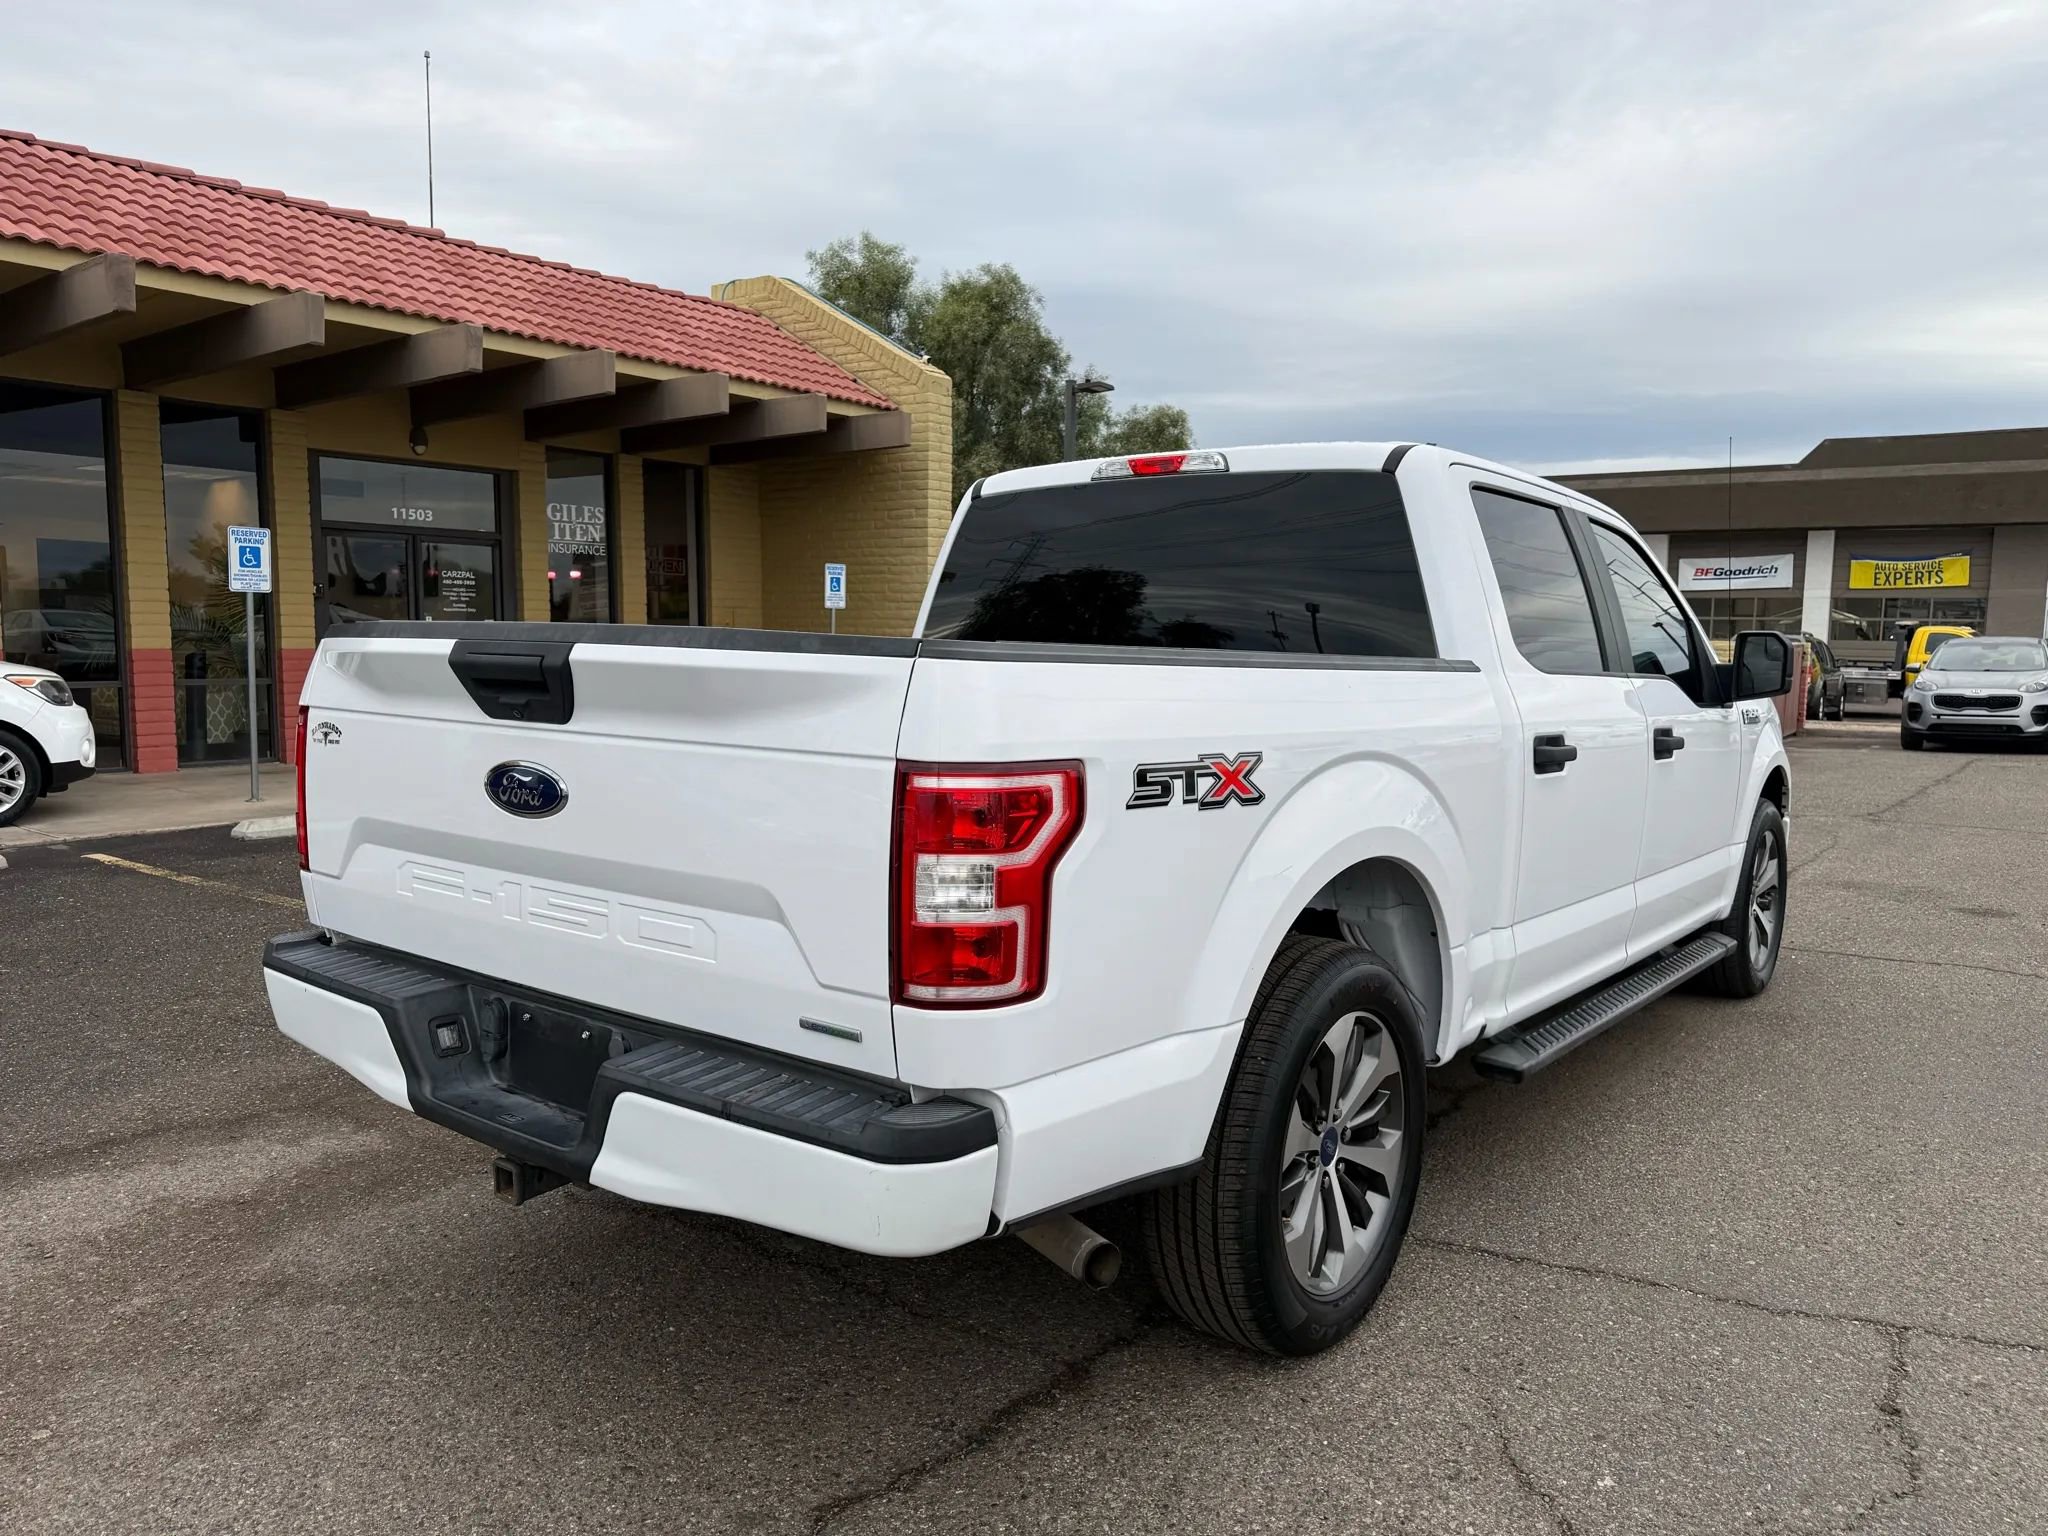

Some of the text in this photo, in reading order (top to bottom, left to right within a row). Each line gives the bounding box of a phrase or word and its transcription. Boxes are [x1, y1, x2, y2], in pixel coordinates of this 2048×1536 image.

[391, 507, 433, 521] 11503
[546, 503, 605, 524] GILES
[231, 529, 268, 538] RESERVED
[552, 522, 601, 542] ITEN
[234, 537, 265, 545] PARKING
[547, 543, 607, 556] INSURANCE
[1693, 564, 1779, 577] BFGoodrich
[1874, 560, 1944, 571] AUTO SERVICE
[441, 570, 476, 578] CARZPAL
[1873, 570, 1944, 587] EXPERTS
[1125, 751, 1266, 811] STX
[499, 772, 544, 806] Ford
[397, 860, 717, 964] F-150
